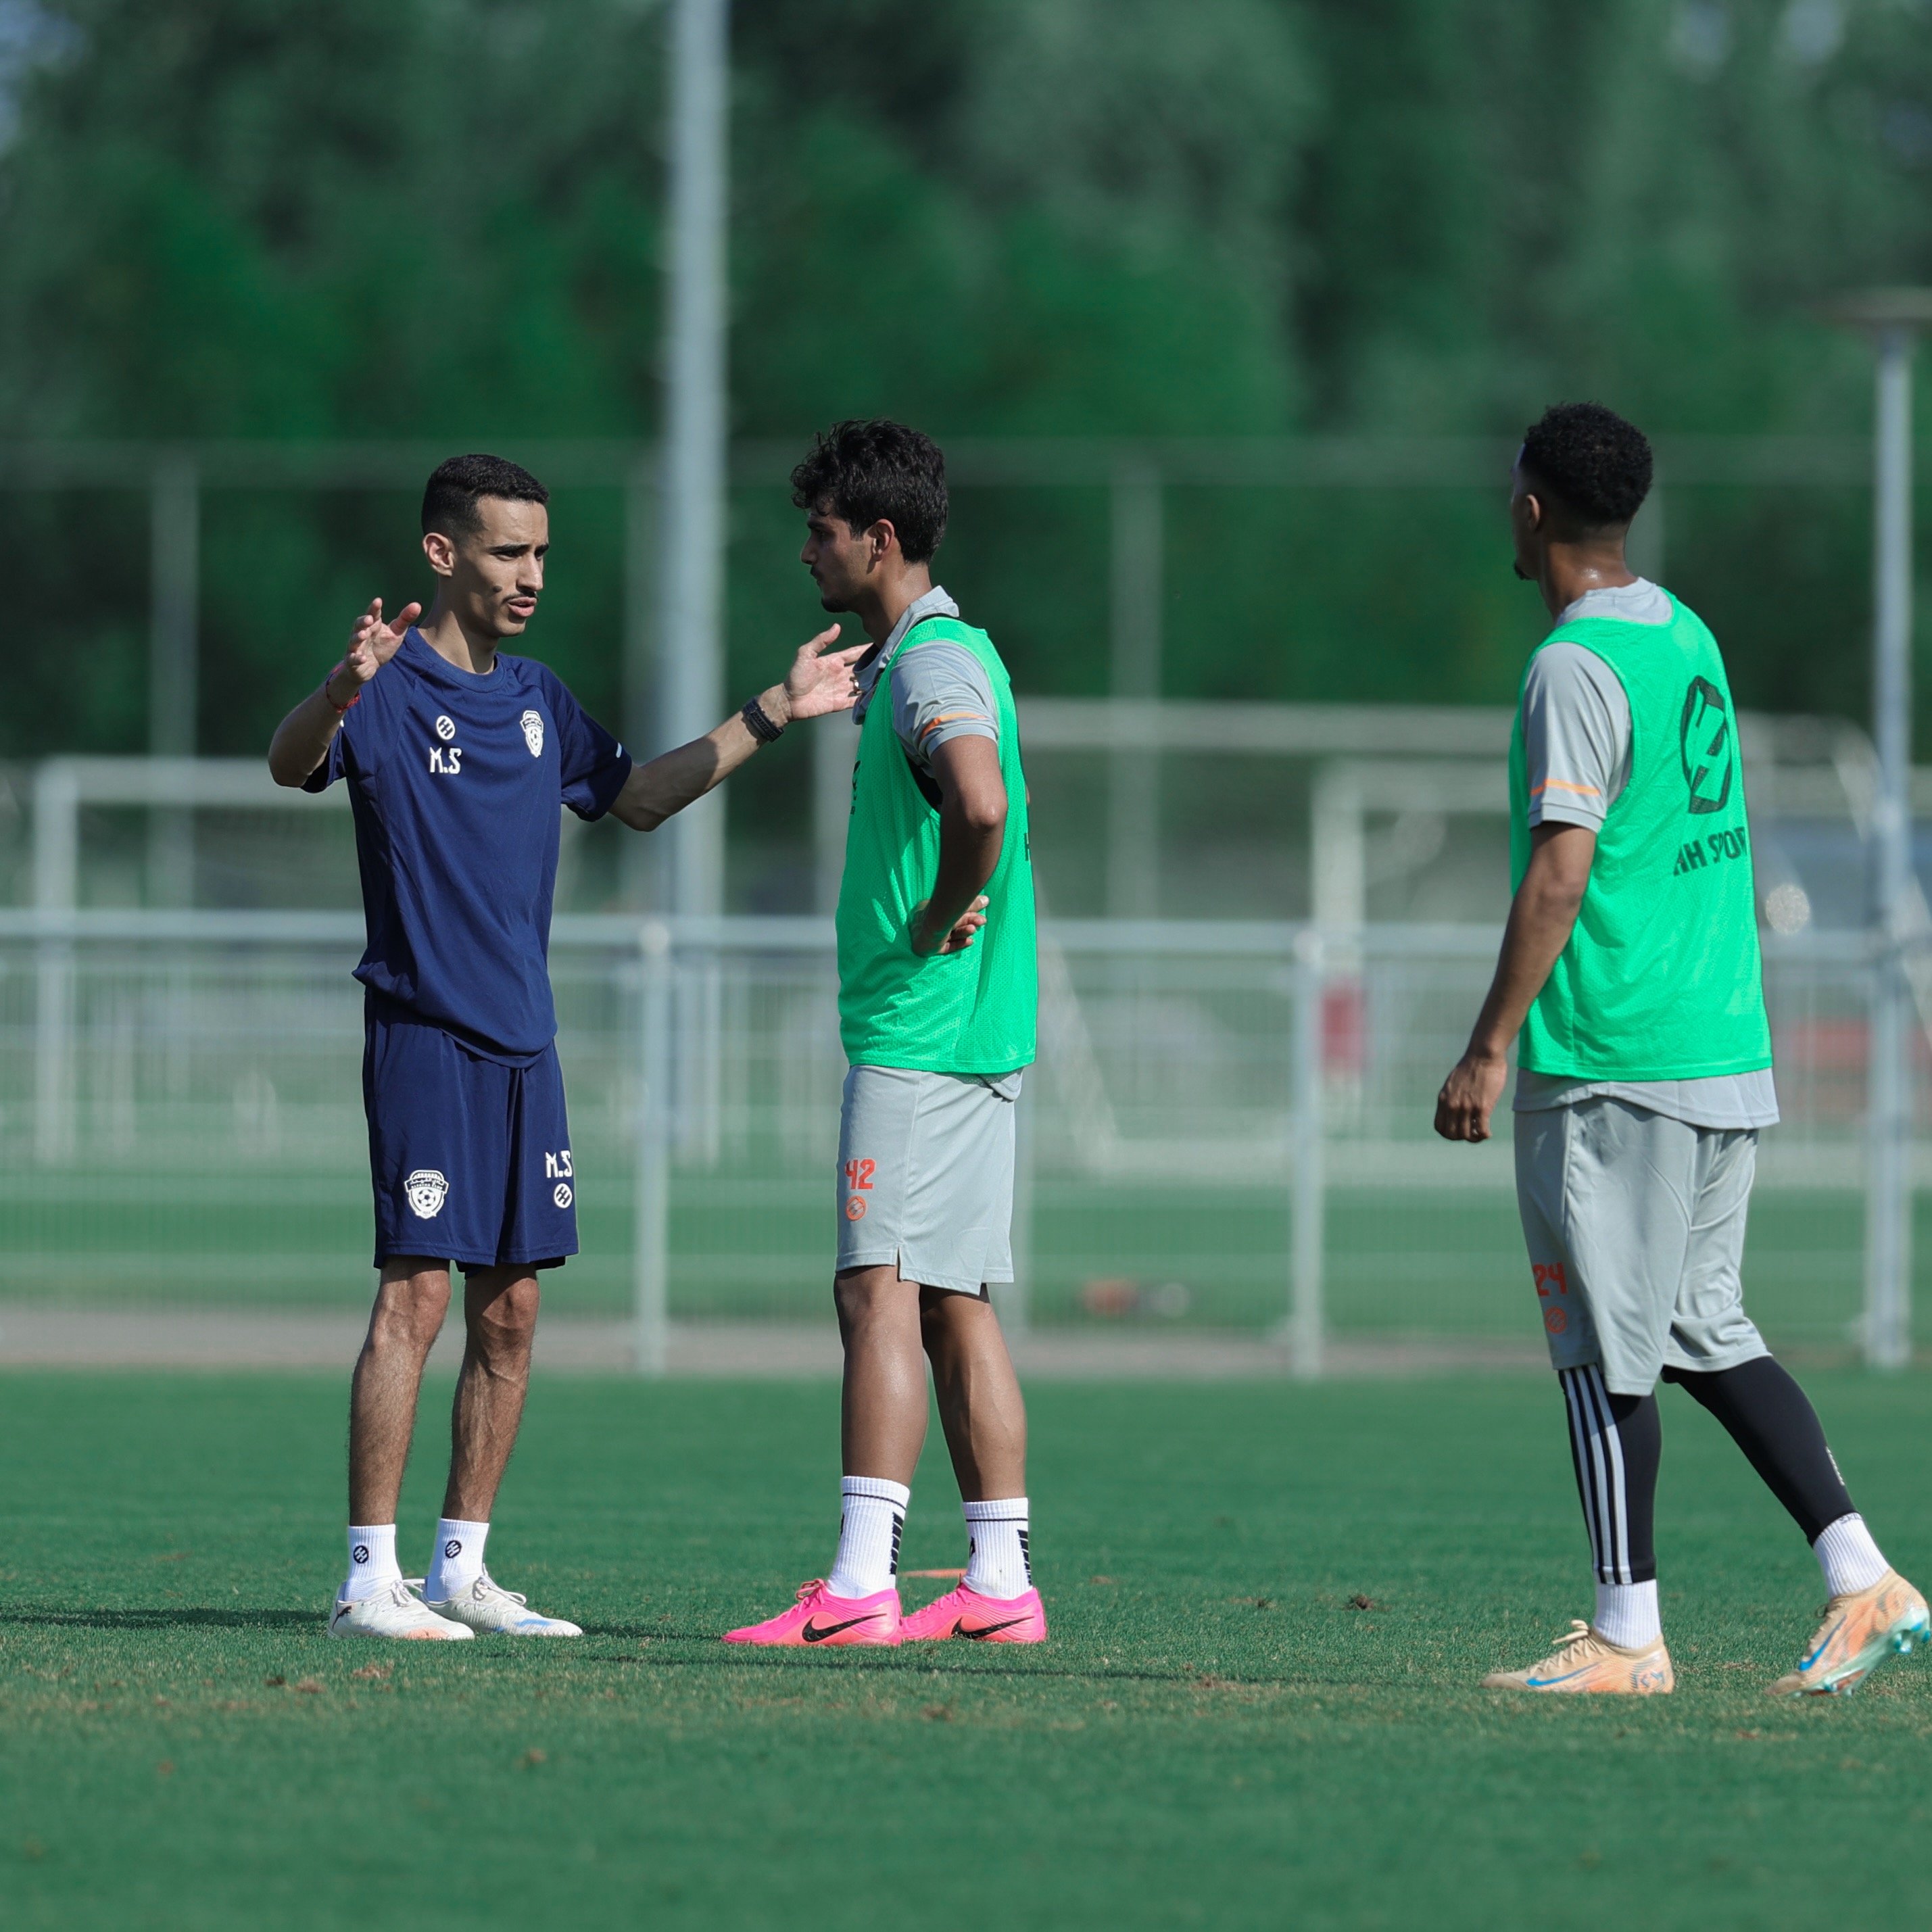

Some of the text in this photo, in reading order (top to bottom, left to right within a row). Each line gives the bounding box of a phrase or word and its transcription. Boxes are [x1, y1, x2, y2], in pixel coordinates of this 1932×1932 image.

[429, 747, 462, 774] M.S
[546, 1150, 572, 1178] M.S
[845, 1159, 875, 1190] 42
[1532, 1262, 1567, 1297] 24
